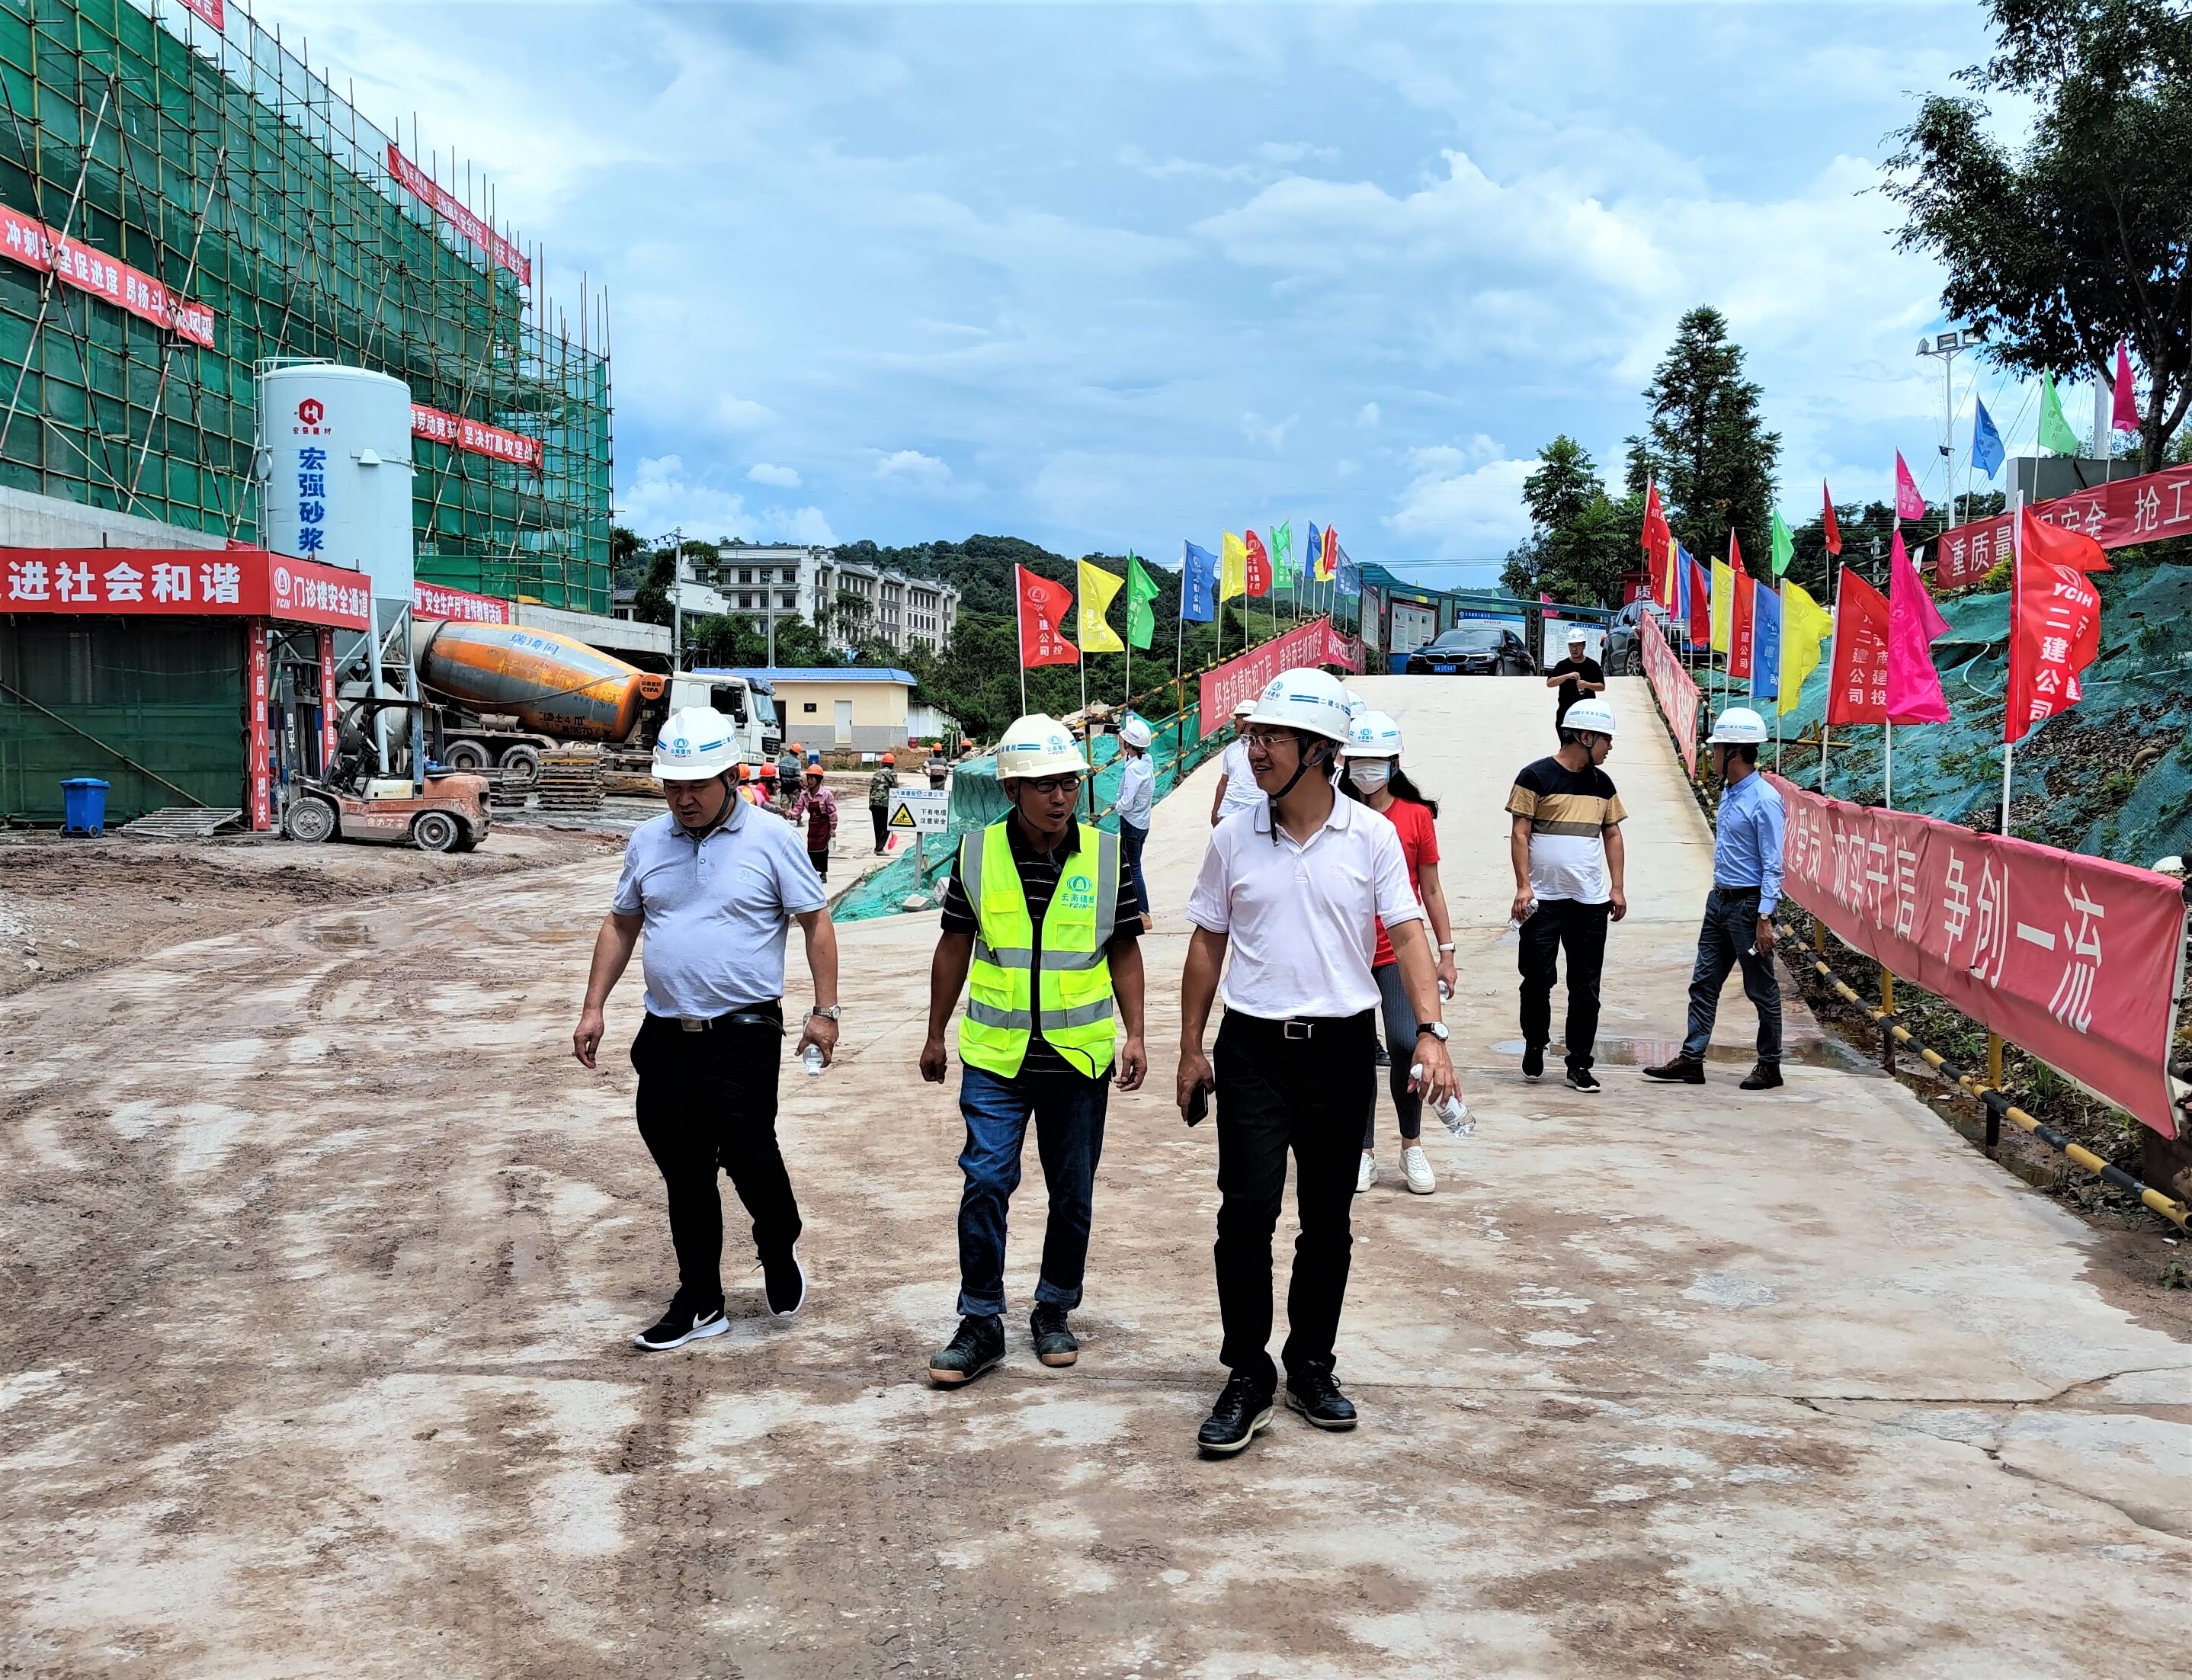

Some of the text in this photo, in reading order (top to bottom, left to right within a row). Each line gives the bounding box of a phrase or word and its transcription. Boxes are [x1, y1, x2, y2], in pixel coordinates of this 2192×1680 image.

[293, 427, 332, 435] 宏强建材
[298, 447, 327, 552] 宏强砂浆
[2134, 479, 2192, 534] 抢工
[8, 561, 240, 604] 进社会和谐
[276, 598, 290, 609] YCIH
[293, 575, 368, 618] 门诊楼安全通道
[2053, 582, 2093, 608] YCIH
[1740, 619, 1751, 668] 二建公司
[1848, 629, 1872, 704] 二建公司
[1871, 633, 1889, 706] 云南建投
[2029, 607, 2072, 721] 二建公司
[255, 626, 267, 824] 工作质量人人把关
[1826, 817, 1916, 943] 诚实守信
[1944, 845, 2105, 1034] 争创一流
